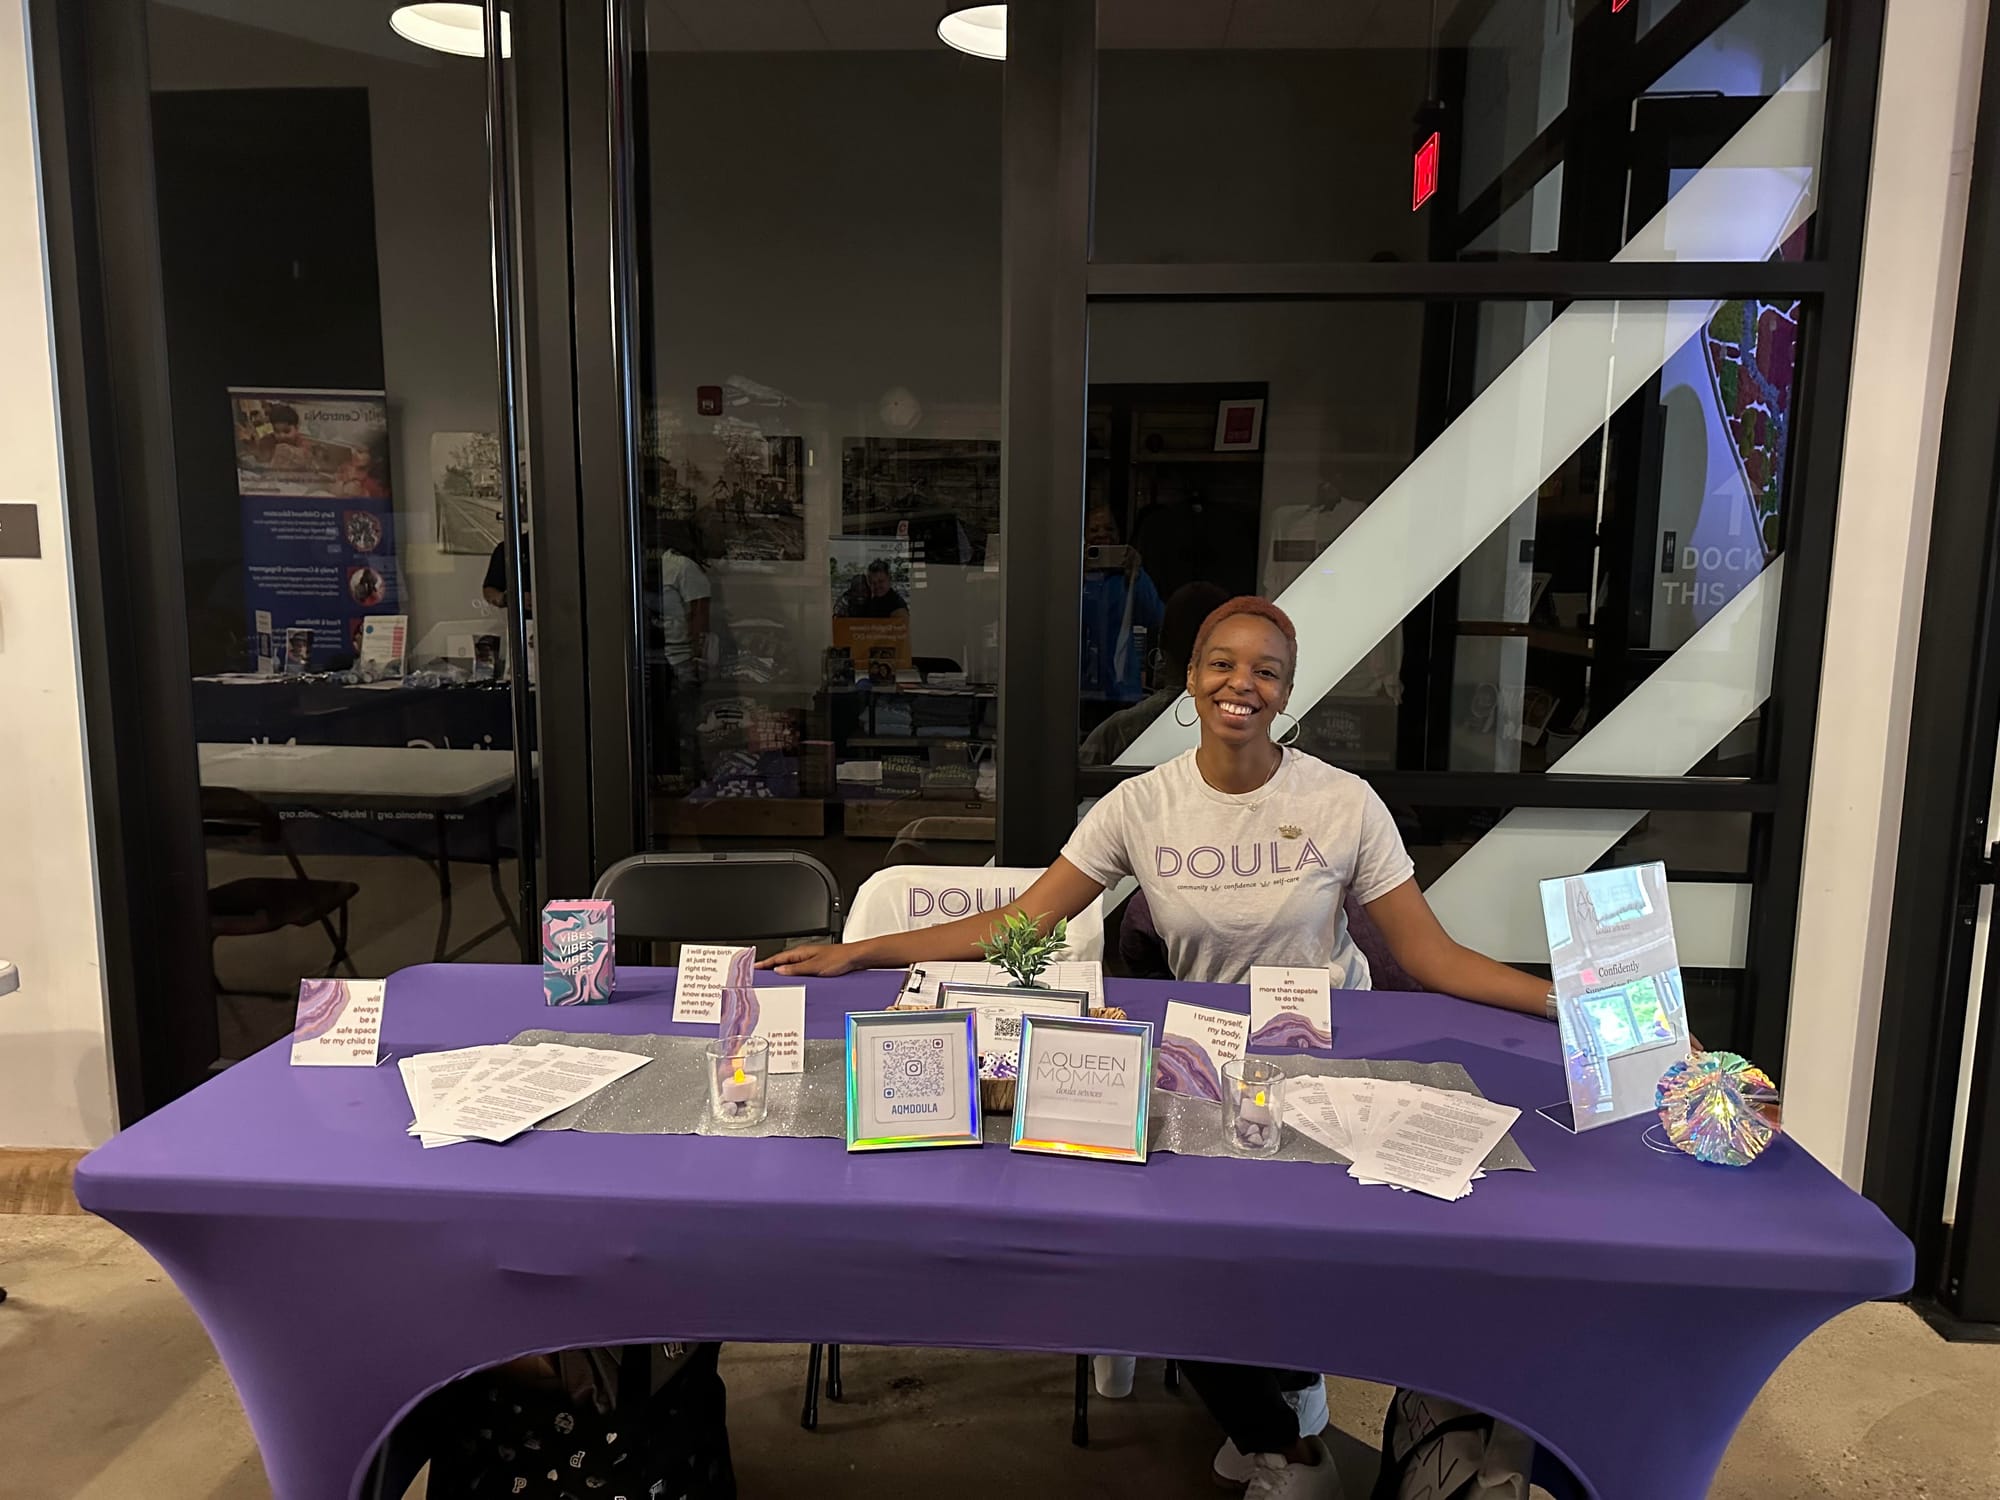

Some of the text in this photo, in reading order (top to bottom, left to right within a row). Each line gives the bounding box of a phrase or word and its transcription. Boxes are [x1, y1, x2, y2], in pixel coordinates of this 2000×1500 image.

[1682, 547, 1763, 570] DOCK
[1662, 582, 1725, 605] THIS
[1156, 838, 1328, 879] DOULA
[1177, 876, 1300, 892] community confidence self-care
[560, 931, 594, 942] VIBES
[560, 941, 594, 954] VIBES
[560, 953, 594, 964] VIBES
[560, 965, 594, 976] VIBES
[1598, 961, 1640, 978] Confidently
[696, 974, 711, 982] baby
[353, 1006, 379, 1014] always
[1198, 1014, 1215, 1023] trust
[1217, 1017, 1243, 1028] myself,
[1208, 1027, 1241, 1040] my body,
[1212, 1038, 1225, 1046] and
[1038, 1051, 1126, 1072] AQUEEN
[1037, 1066, 1125, 1088] MOMMA
[891, 1103, 938, 1115] AQMDOULA
